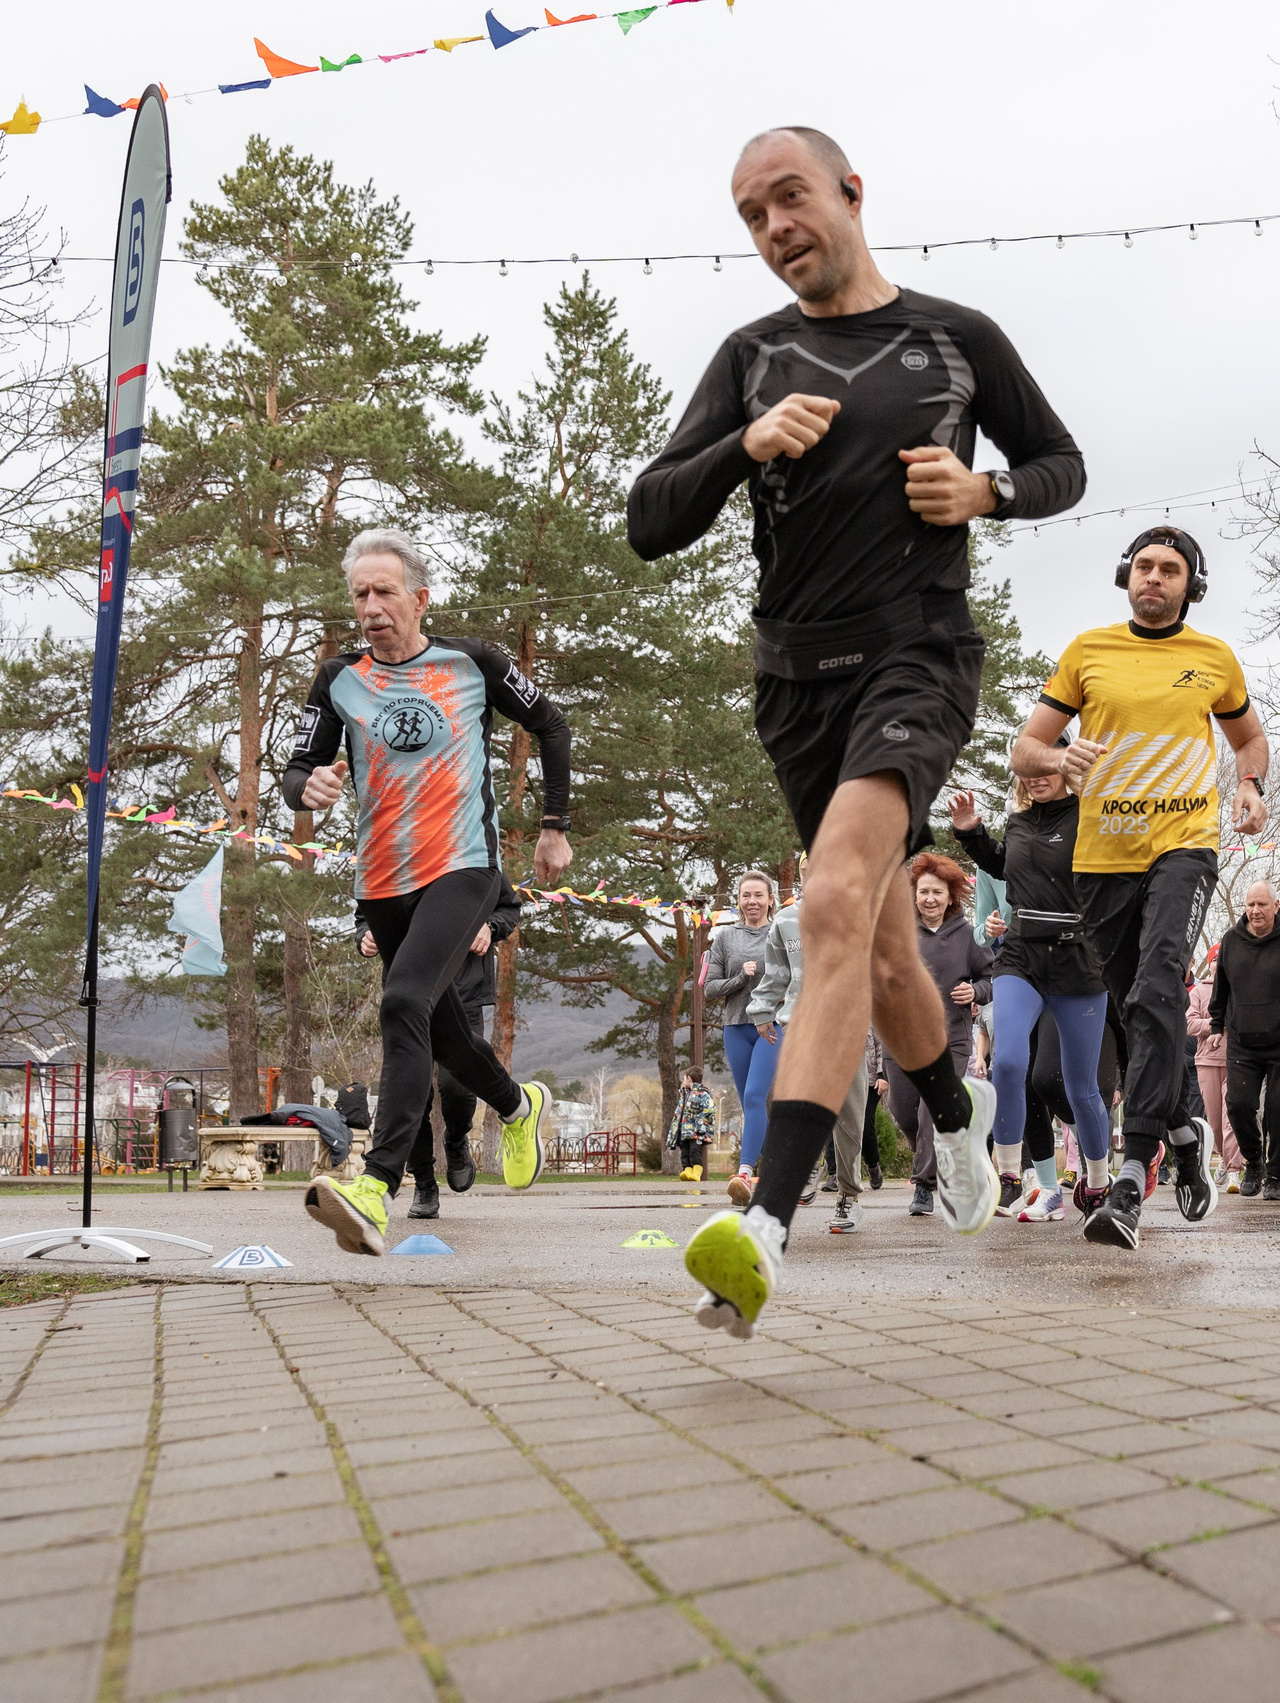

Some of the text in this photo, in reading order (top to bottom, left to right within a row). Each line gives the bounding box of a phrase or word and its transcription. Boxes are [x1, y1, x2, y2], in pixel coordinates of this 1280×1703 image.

[371, 697, 445, 729] БЕГ ПО ГОРЯЧЕМУ
[1101, 799, 1148, 815] КРОСС
[1098, 816, 1149, 835] 2025
